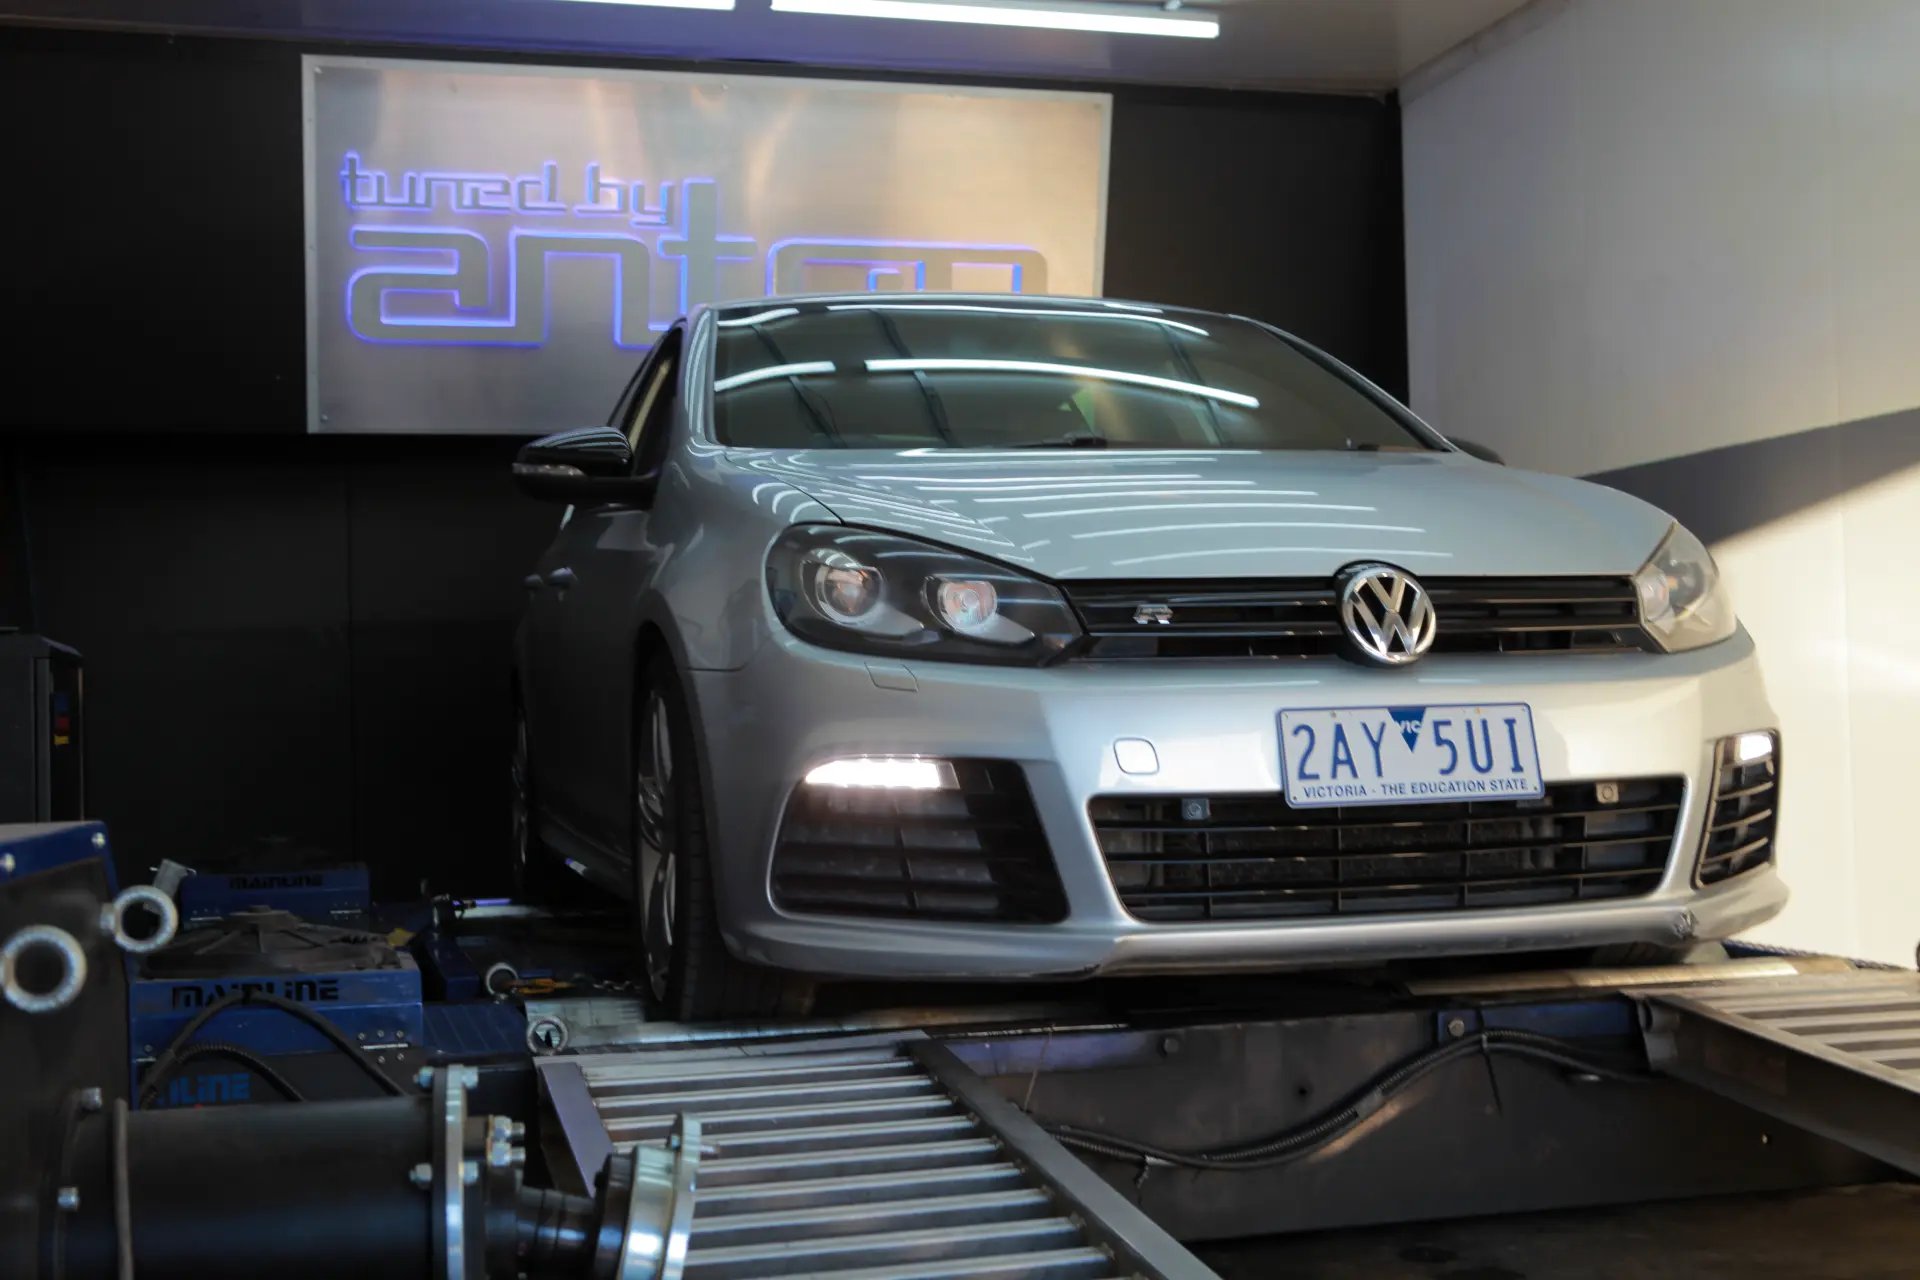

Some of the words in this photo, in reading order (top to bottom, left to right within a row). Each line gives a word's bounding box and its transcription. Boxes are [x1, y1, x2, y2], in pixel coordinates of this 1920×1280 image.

[341, 151, 567, 213] tuned
[573, 162, 676, 228] by
[1291, 719, 1387, 781] 2AY
[1432, 717, 1525, 776] 5UI
[1303, 784, 1367, 799] VICTORIA
[1381, 782, 1406, 796] THE
[1410, 780, 1487, 795] EDUCATION
[1489, 778, 1529, 792] STATE
